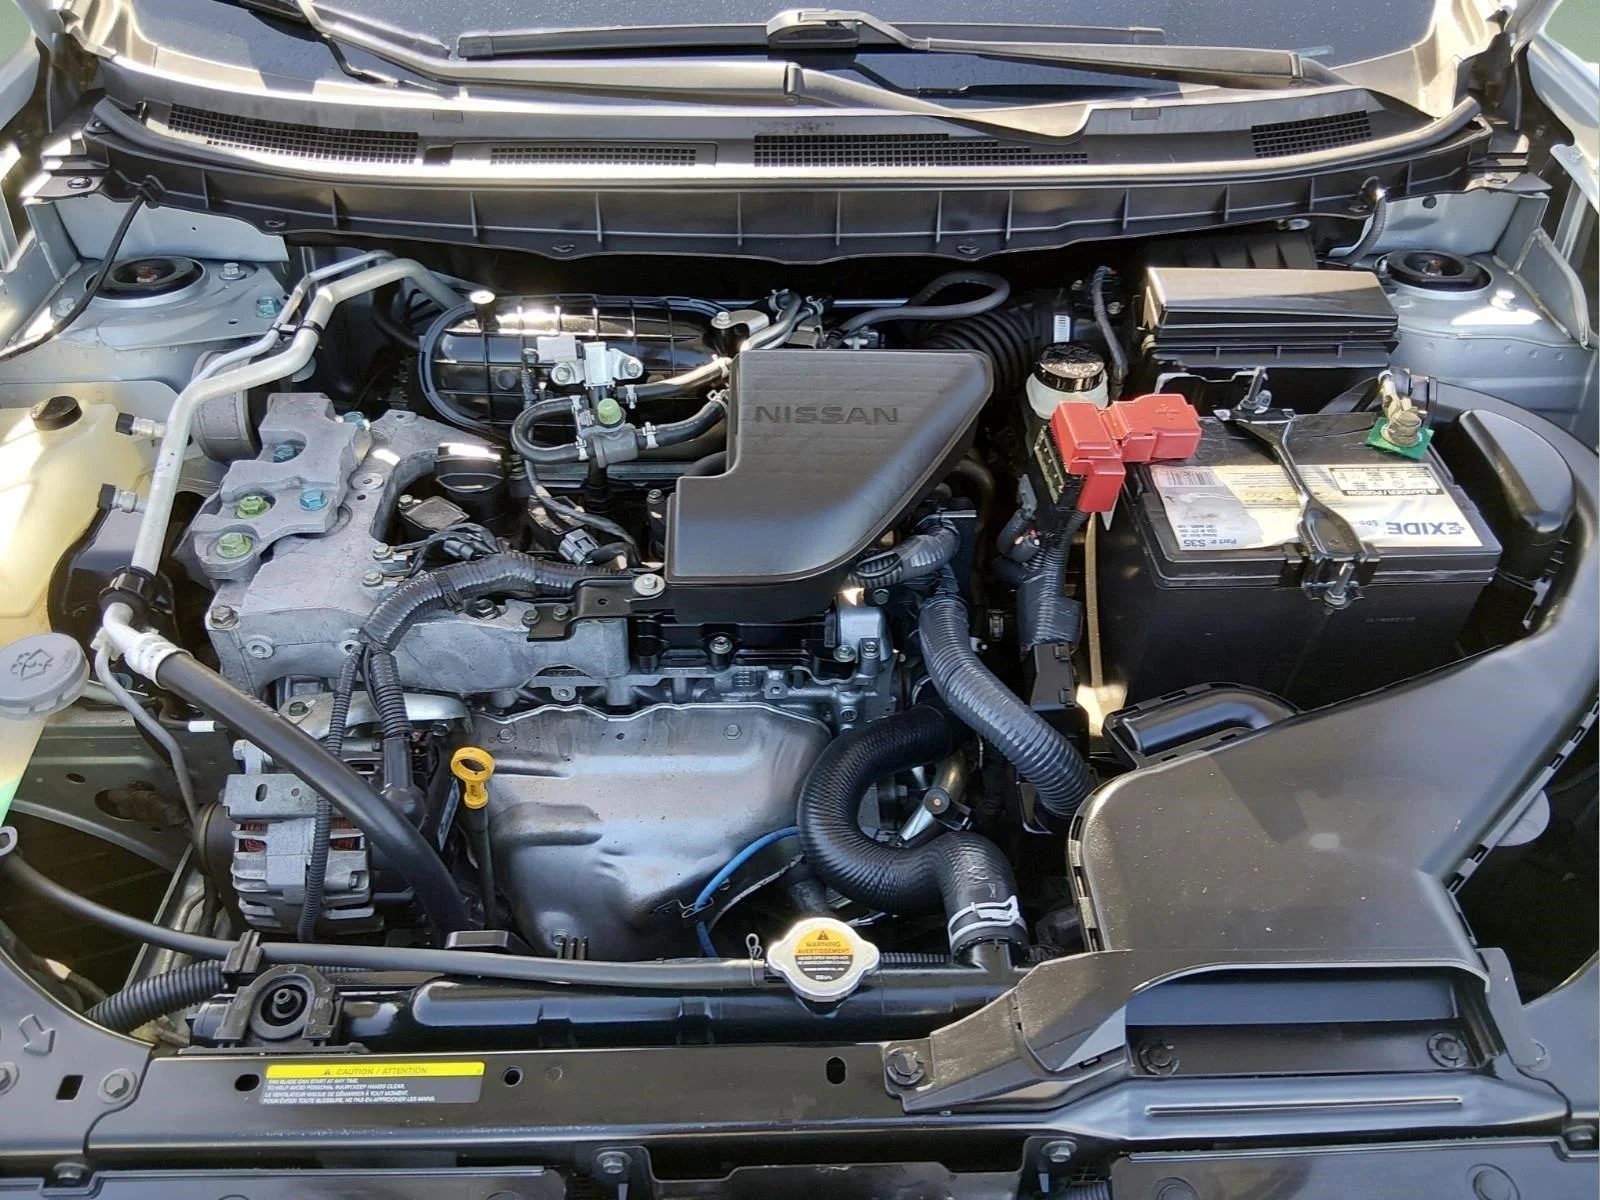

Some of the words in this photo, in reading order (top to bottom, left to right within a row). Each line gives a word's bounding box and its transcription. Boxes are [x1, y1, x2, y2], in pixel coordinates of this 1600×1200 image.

[754, 406, 897, 425] NISSAN
[1385, 522, 1464, 535] EXIDE
[1183, 539, 1206, 547] S35
